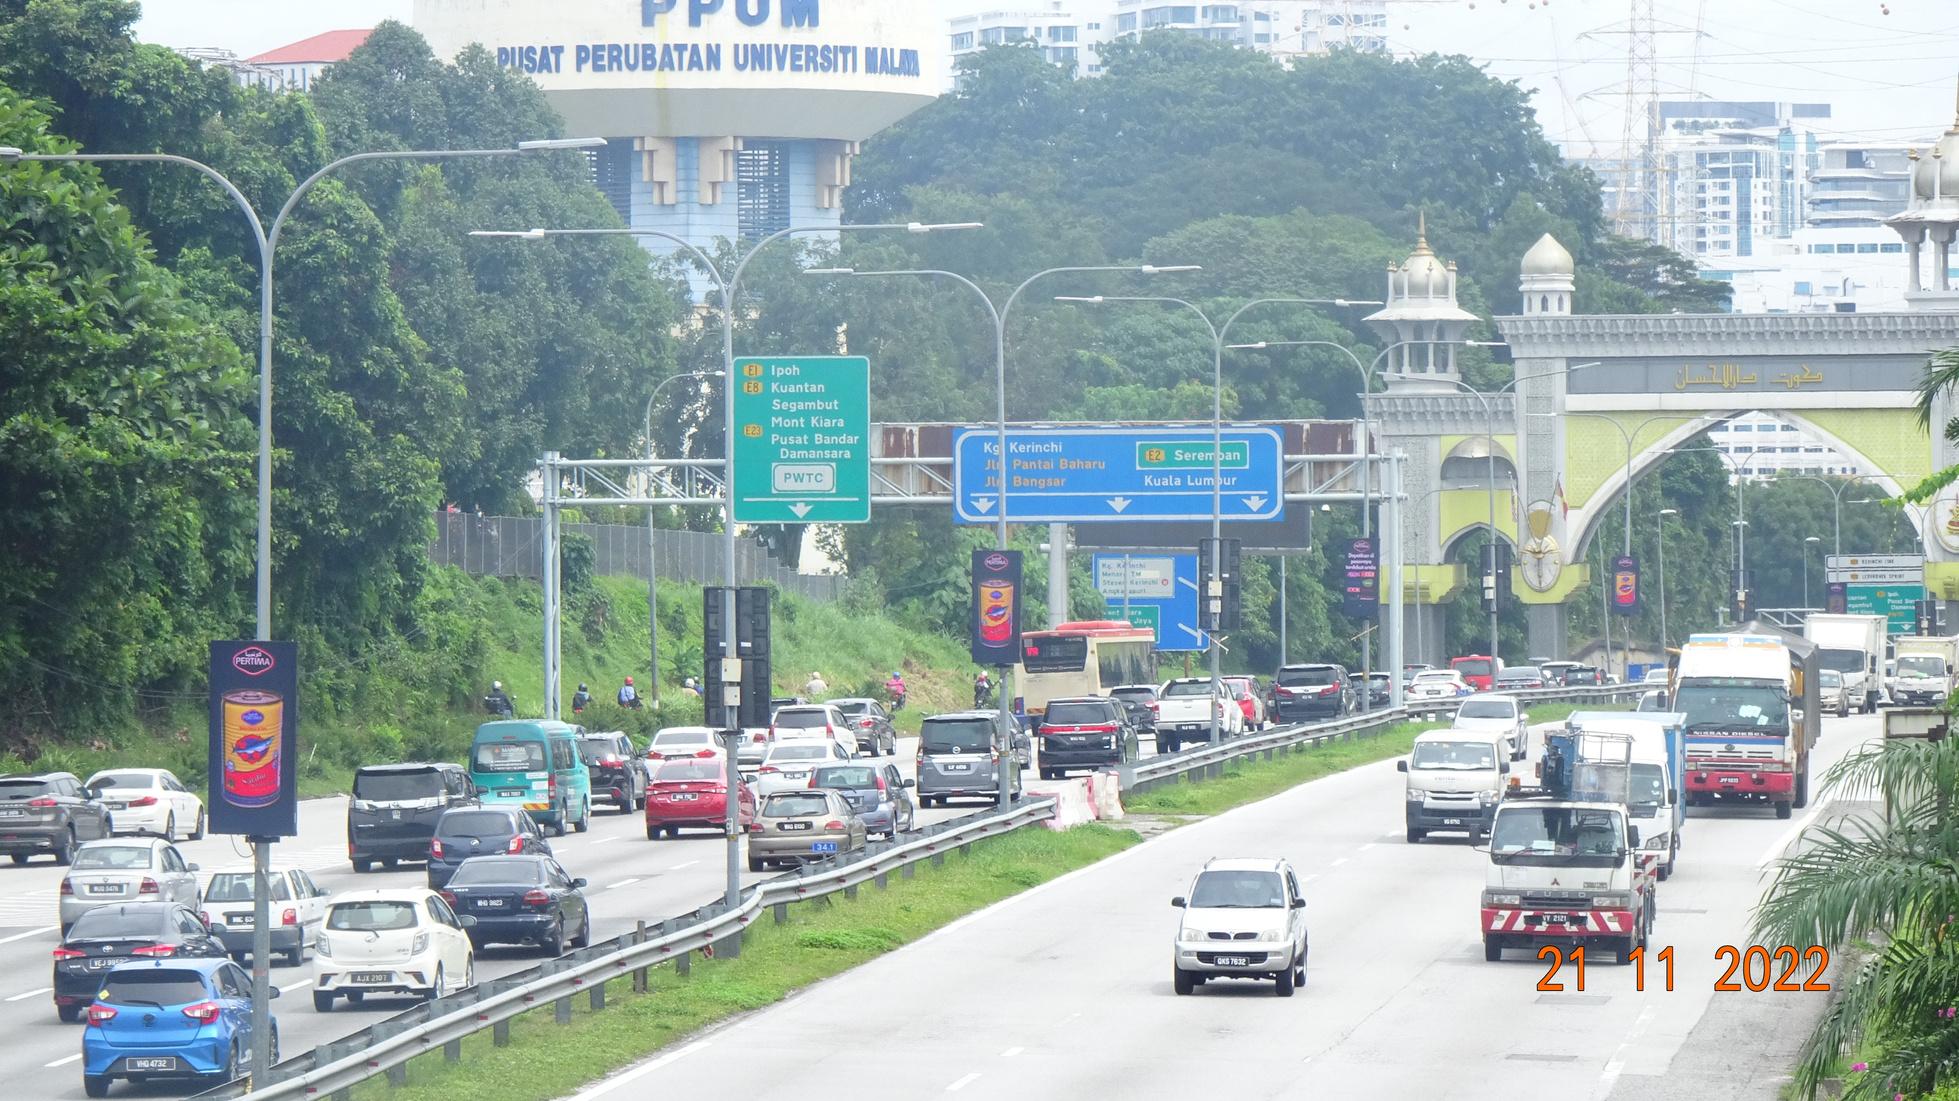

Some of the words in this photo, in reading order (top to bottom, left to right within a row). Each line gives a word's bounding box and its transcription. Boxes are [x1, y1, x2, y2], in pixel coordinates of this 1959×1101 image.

[497, 46, 564, 74] PUSAT
[575, 43, 722, 73] PERUBATAN
[733, 43, 857, 73] UNIVERSITI
[864, 46, 920, 77] MALAYA
[771, 365, 800, 377] Ipoh
[747, 382, 760, 393] E8
[771, 382, 825, 393] Kuantan
[772, 400, 839, 412] Segambut
[771, 416, 805, 428] Mont
[811, 416, 845, 428] Kiara
[771, 434, 808, 445] Pusat
[815, 433, 859, 445] Bandar
[1010, 441, 1063, 453] Kerinchi
[780, 448, 852, 459] Damansara
[1013, 459, 1054, 470] Pantai
[1060, 458, 1105, 469] Baharu
[784, 473, 824, 484] PWTC
[1013, 475, 1066, 488] Bangsar
[1144, 475, 1181, 486] Kuala
[235, 656, 271, 666] PERTIMA
[150, 1059, 167, 1067] 4732
